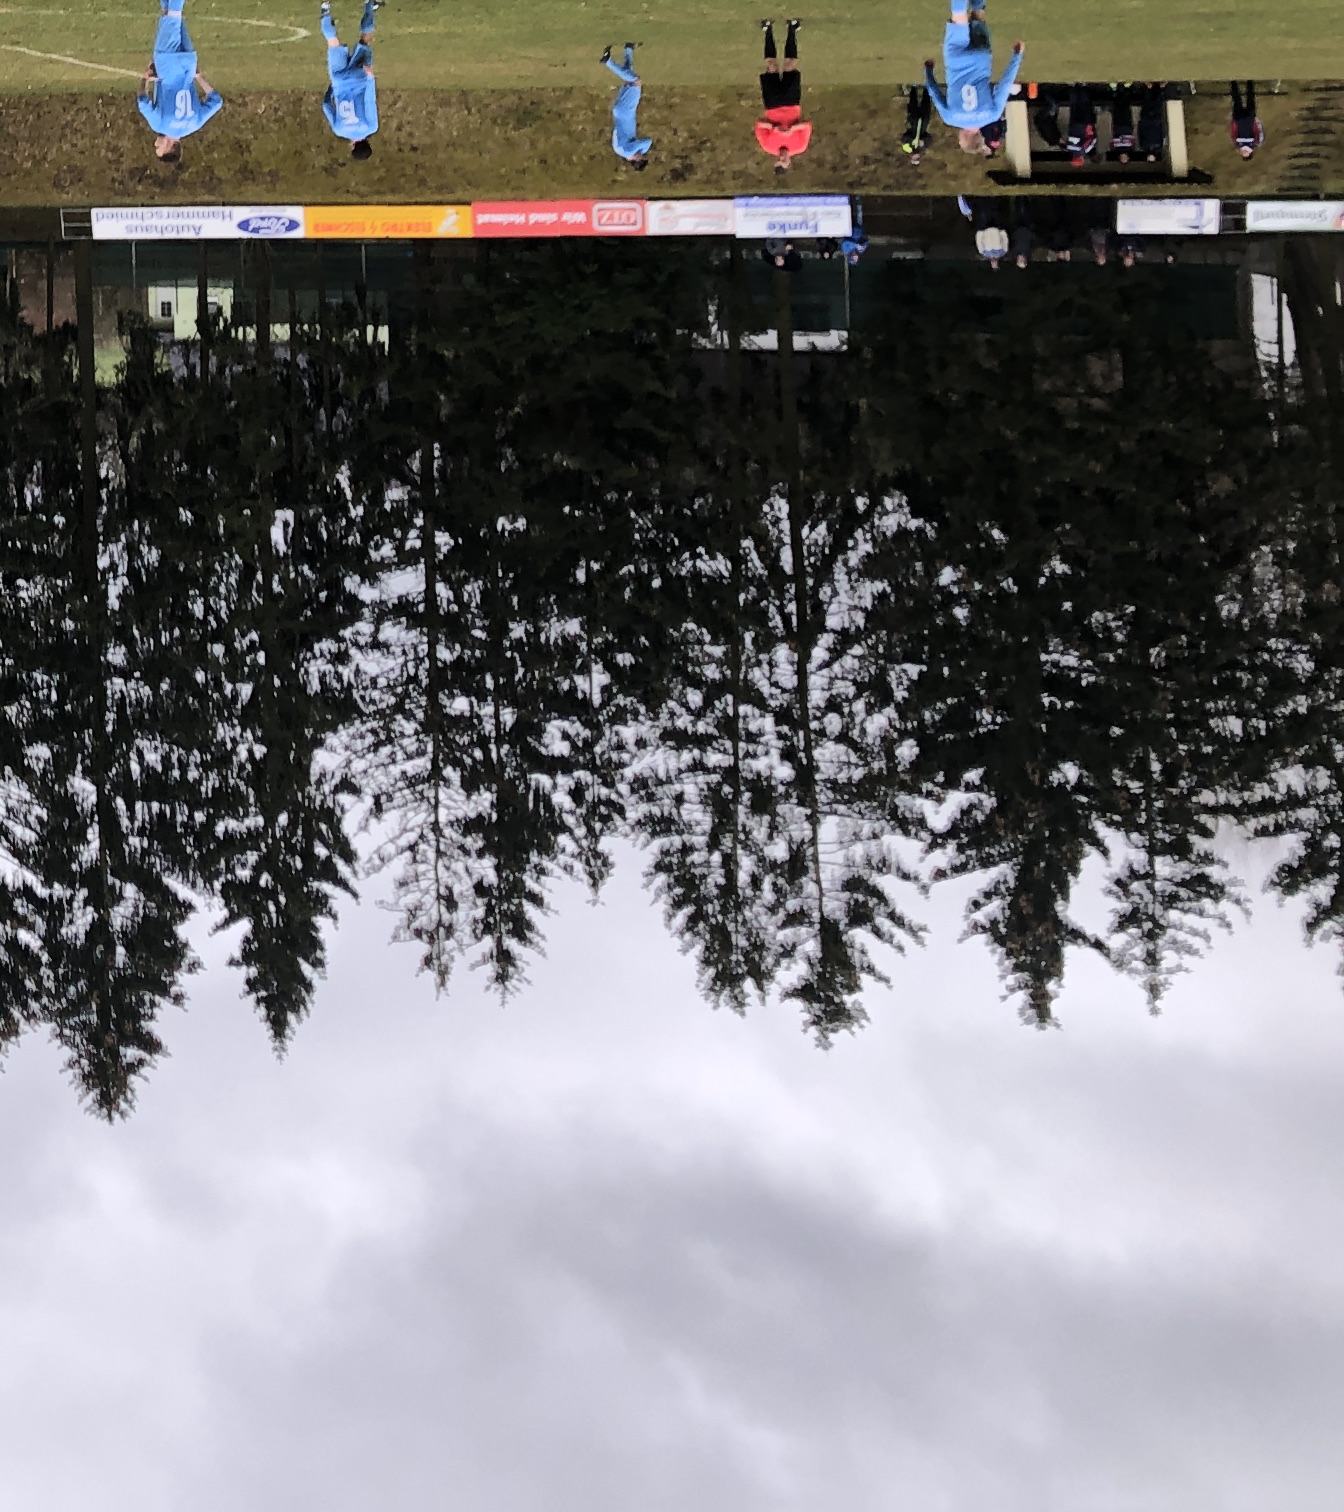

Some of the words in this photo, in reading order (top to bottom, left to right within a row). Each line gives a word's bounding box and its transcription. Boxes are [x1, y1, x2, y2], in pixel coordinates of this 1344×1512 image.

[174, 89, 195, 119] 16
[961, 83, 978, 112] 6
[95, 210, 234, 223] Hammerschmied
[528, 212, 558, 225] sind
[561, 212, 587, 225] Wir
[597, 210, 636, 225] OTZ
[124, 223, 203, 237] Autohaus
[247, 217, 291, 236] Ford
[766, 220, 819, 234] Funke
